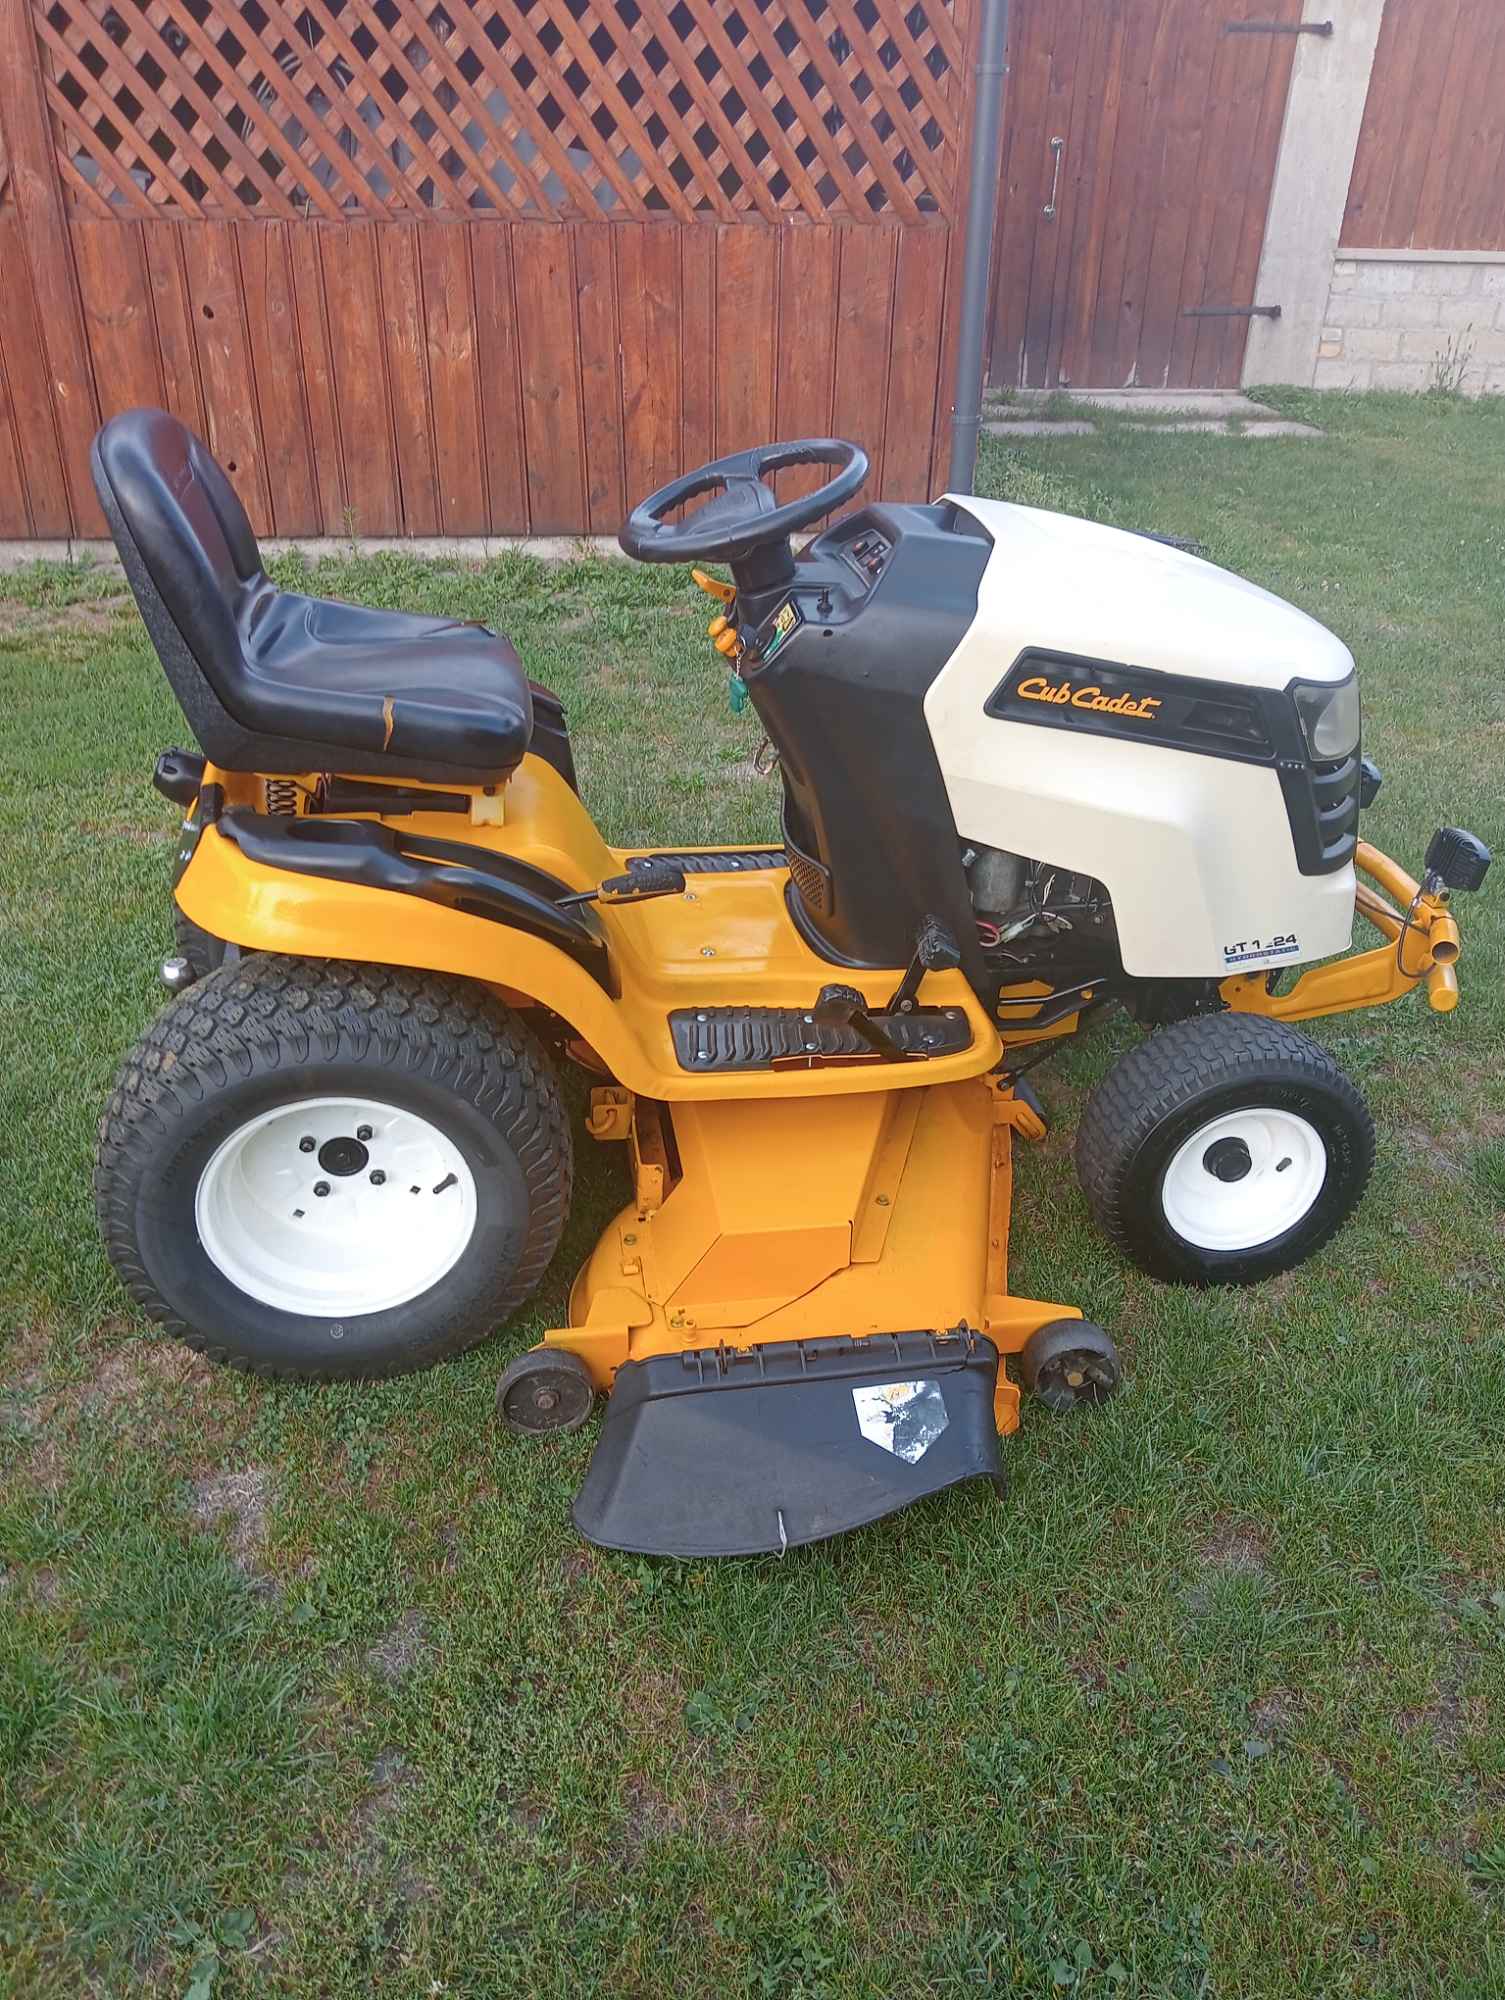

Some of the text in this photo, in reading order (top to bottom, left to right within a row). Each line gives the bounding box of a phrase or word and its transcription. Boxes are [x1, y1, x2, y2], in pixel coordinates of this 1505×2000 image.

[1016, 677, 1162, 719] Cub Cadet
[1224, 942, 1247, 955] GT
[1252, 934, 1297, 950] 124
